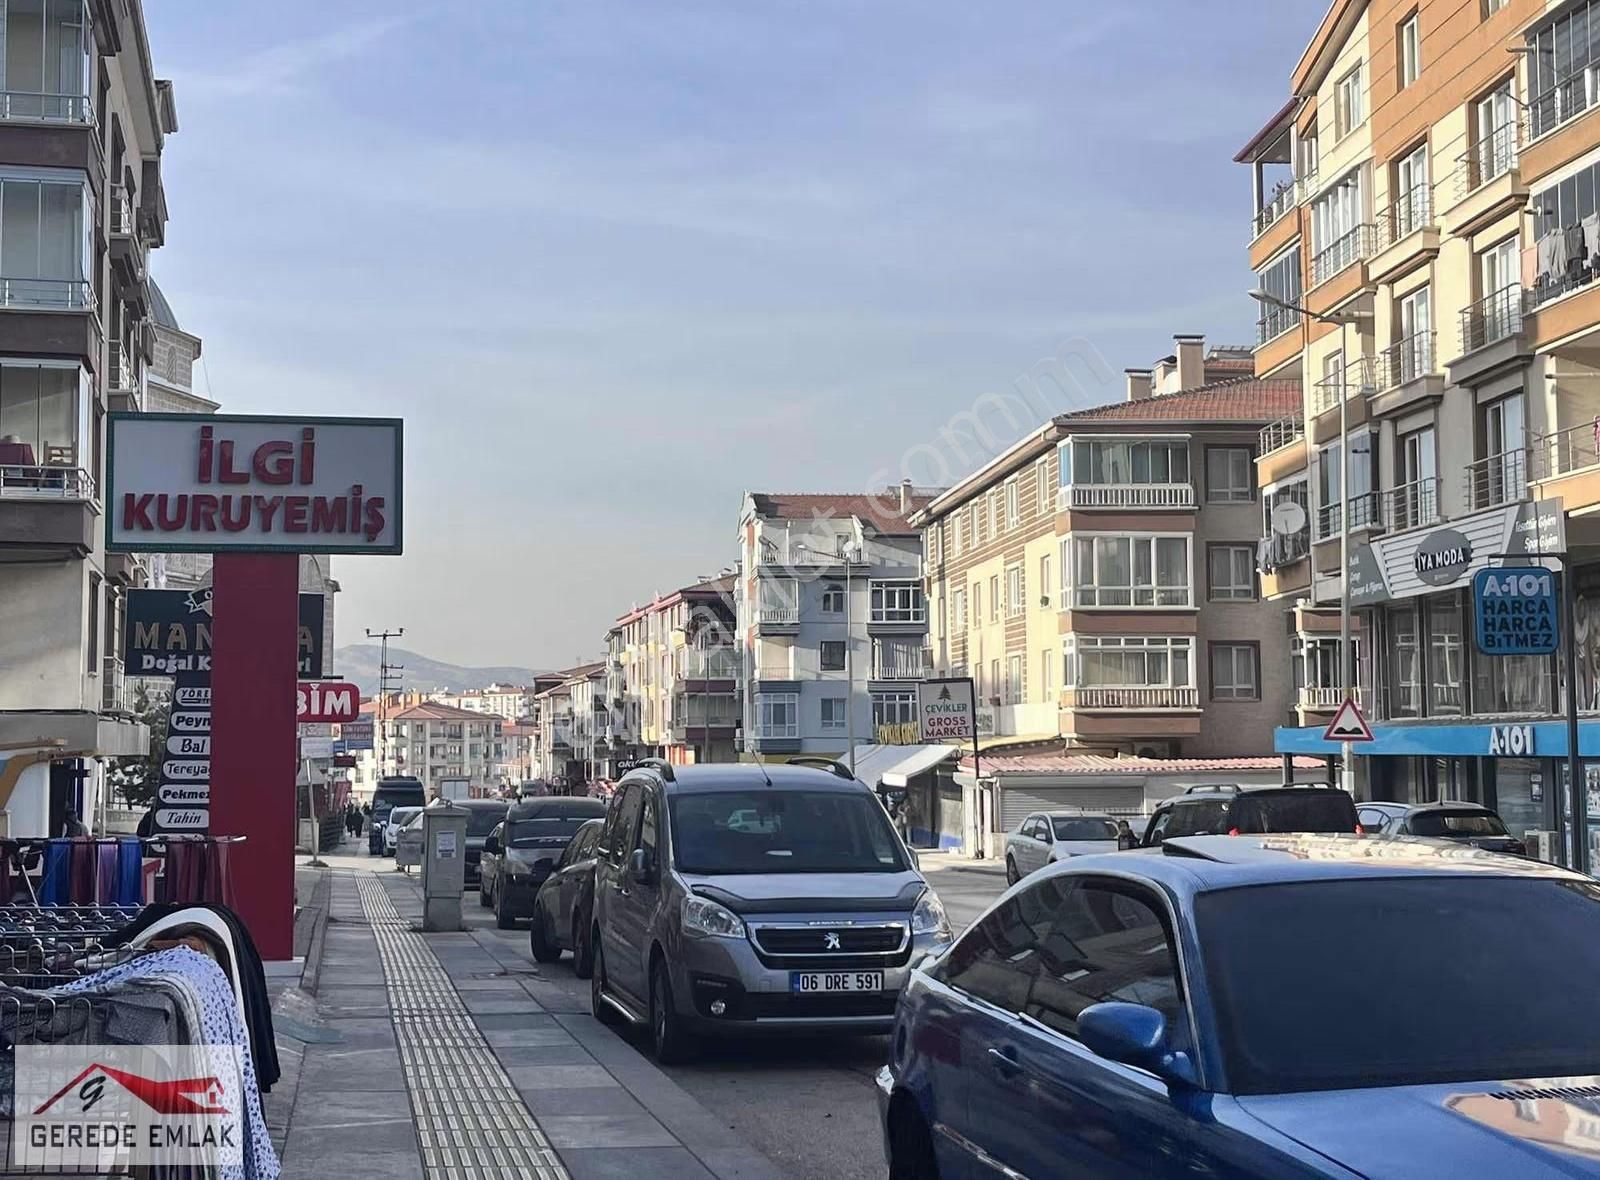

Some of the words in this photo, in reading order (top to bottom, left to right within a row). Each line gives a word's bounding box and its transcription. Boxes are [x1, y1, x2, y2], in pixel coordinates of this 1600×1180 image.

[198, 426, 316, 484] İLGİ
[123, 485, 385, 542] KURUYEMİŞ
[1435, 547, 1464, 568] MODA
[1482, 599, 1550, 615] HARCA
[1483, 616, 1552, 632] HARCA
[142, 654, 193, 674] Doğal
[925, 702, 967, 715] ÇEVİKLER
[928, 716, 966, 727] GROSS
[925, 726, 970, 737] MARKET
[180, 738, 206, 753] Bal
[167, 763, 211, 777] Tereya
[166, 811, 202, 824] Tahin
[802, 975, 818, 990] 06
[825, 974, 850, 989] DRE
[857, 973, 879, 989] 591
